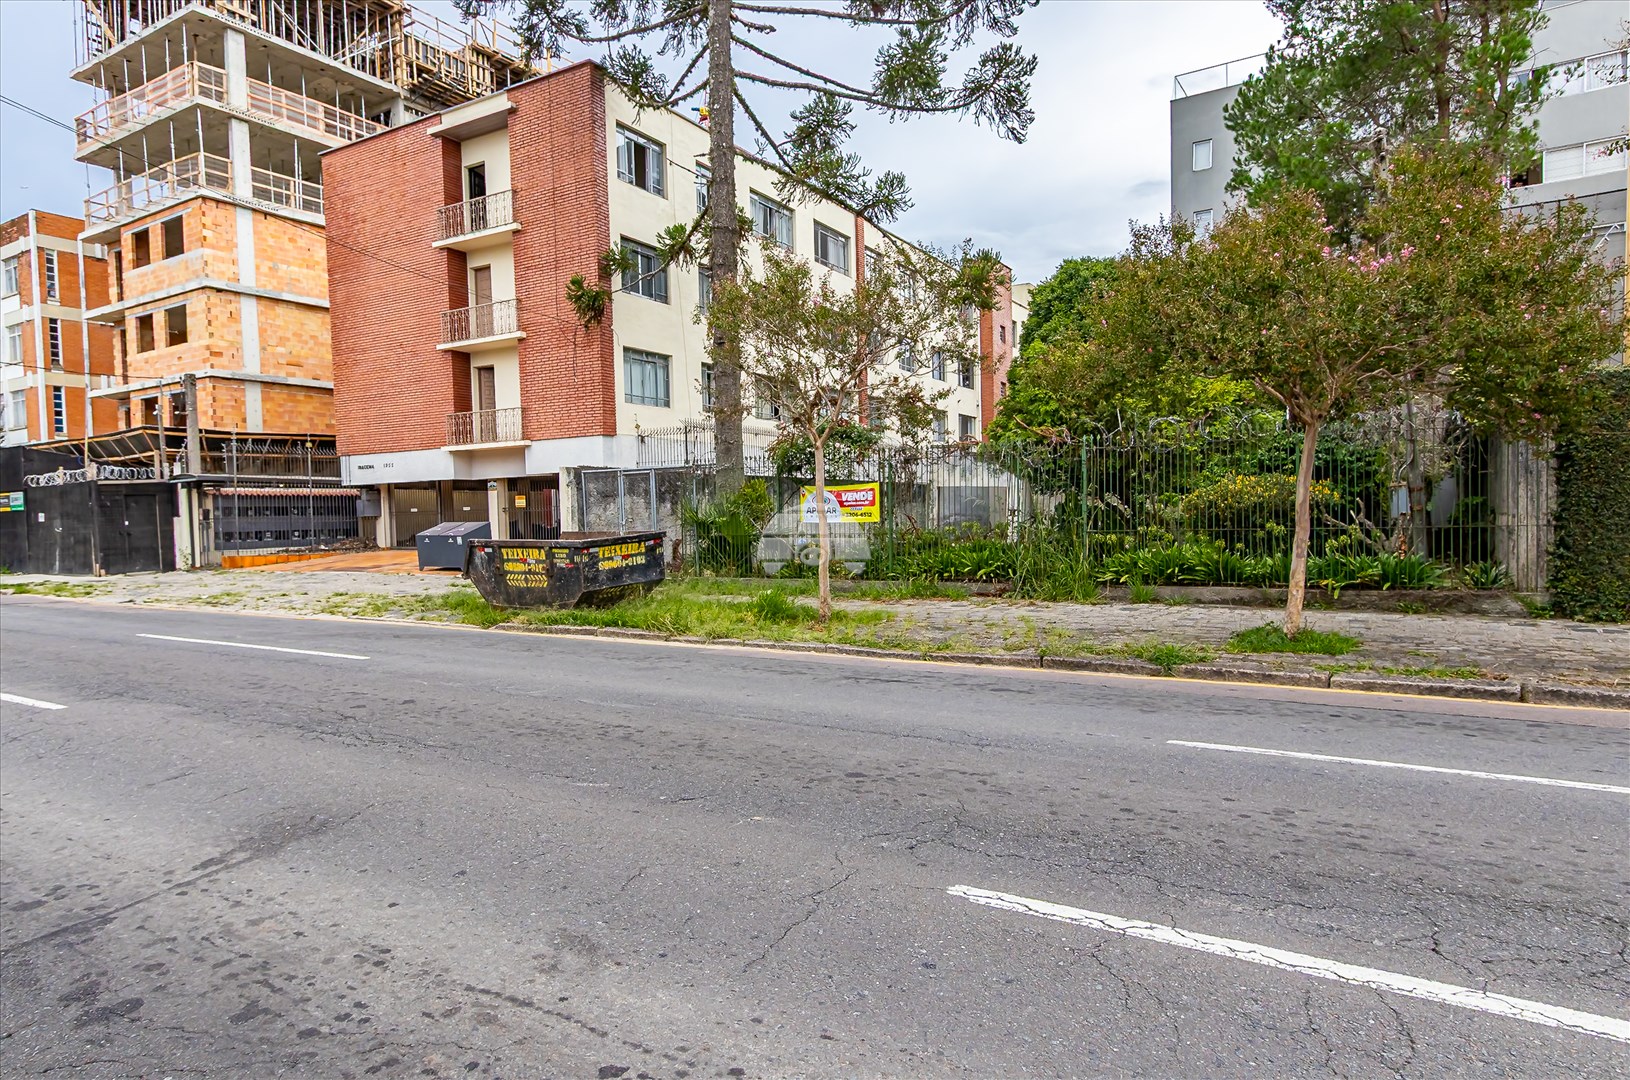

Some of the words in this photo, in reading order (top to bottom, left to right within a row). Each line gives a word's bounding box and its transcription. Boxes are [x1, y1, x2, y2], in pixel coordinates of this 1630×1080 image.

[841, 491, 873, 501] VENDE
[806, 506, 837, 514] APAR
[501, 548, 546, 560] TEIXEIRA
[598, 541, 646, 558] TEIXEIRA
